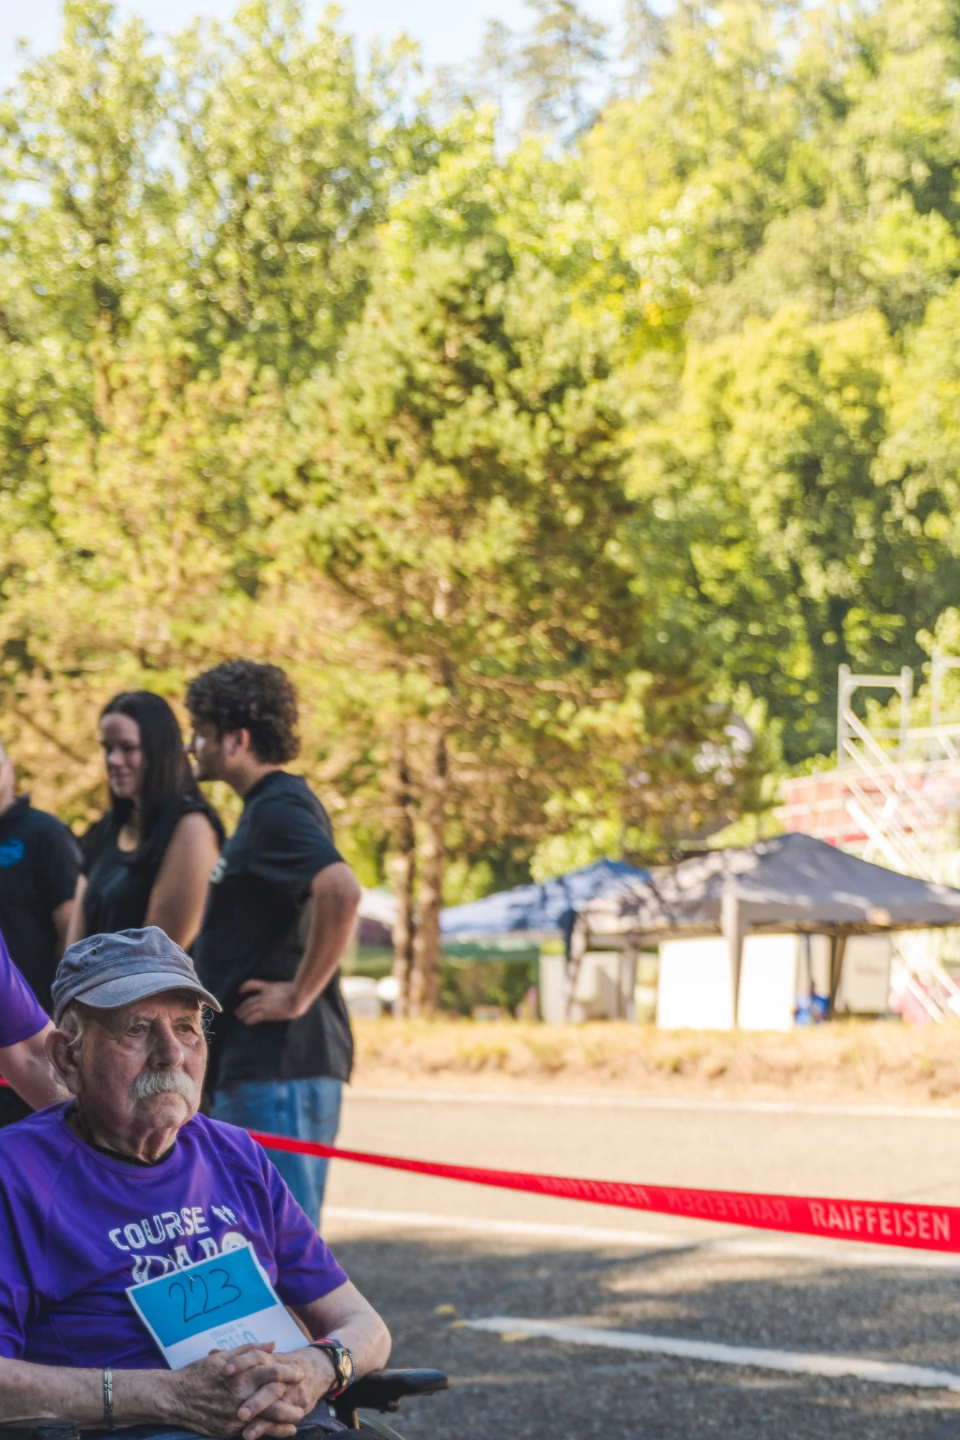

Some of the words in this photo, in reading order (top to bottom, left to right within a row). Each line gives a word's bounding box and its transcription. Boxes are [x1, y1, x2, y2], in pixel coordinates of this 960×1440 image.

[108, 1206, 210, 1251] COURSE
[809, 1200, 950, 1242] RAIFFEISEN
[168, 1268, 242, 1323] 223
